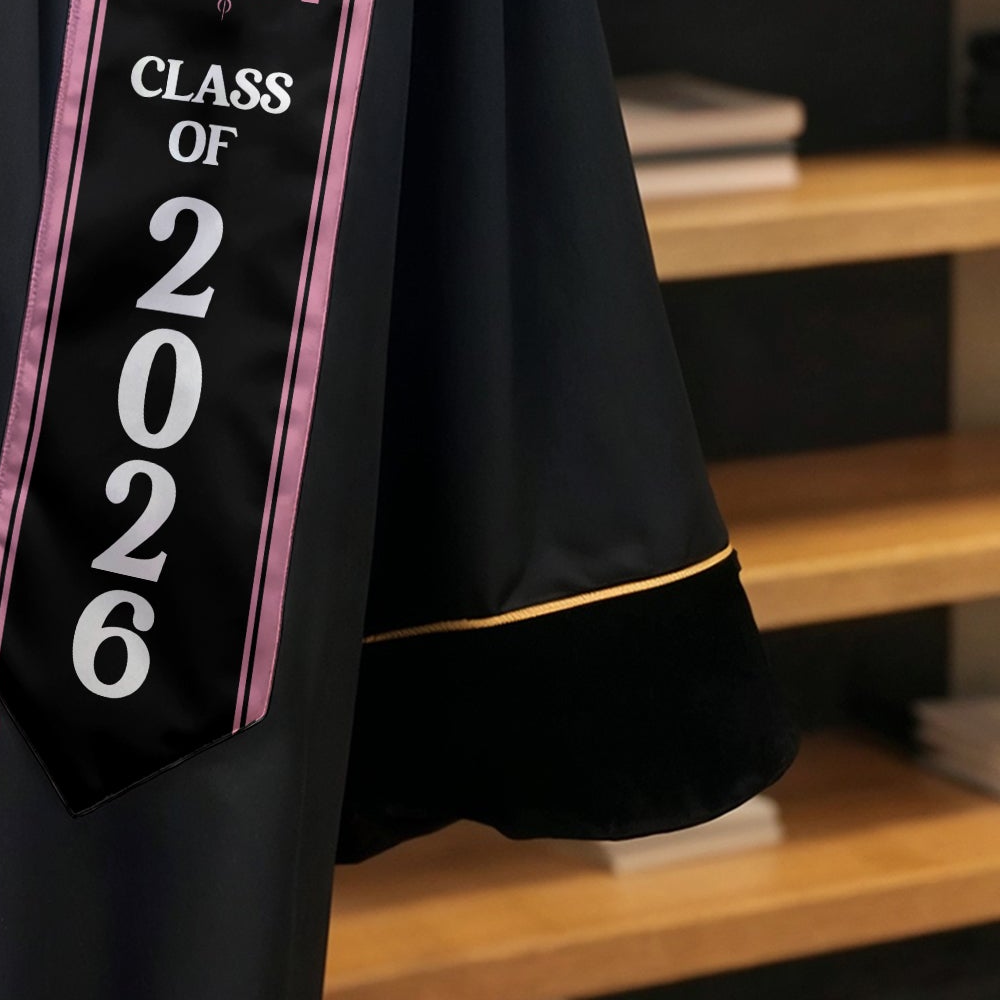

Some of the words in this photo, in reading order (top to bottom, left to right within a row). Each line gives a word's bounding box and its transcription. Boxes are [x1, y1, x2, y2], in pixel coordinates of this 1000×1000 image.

[130, 55, 294, 115] CLASS
[168, 120, 239, 166] OF
[72, 196, 225, 699] 2026
